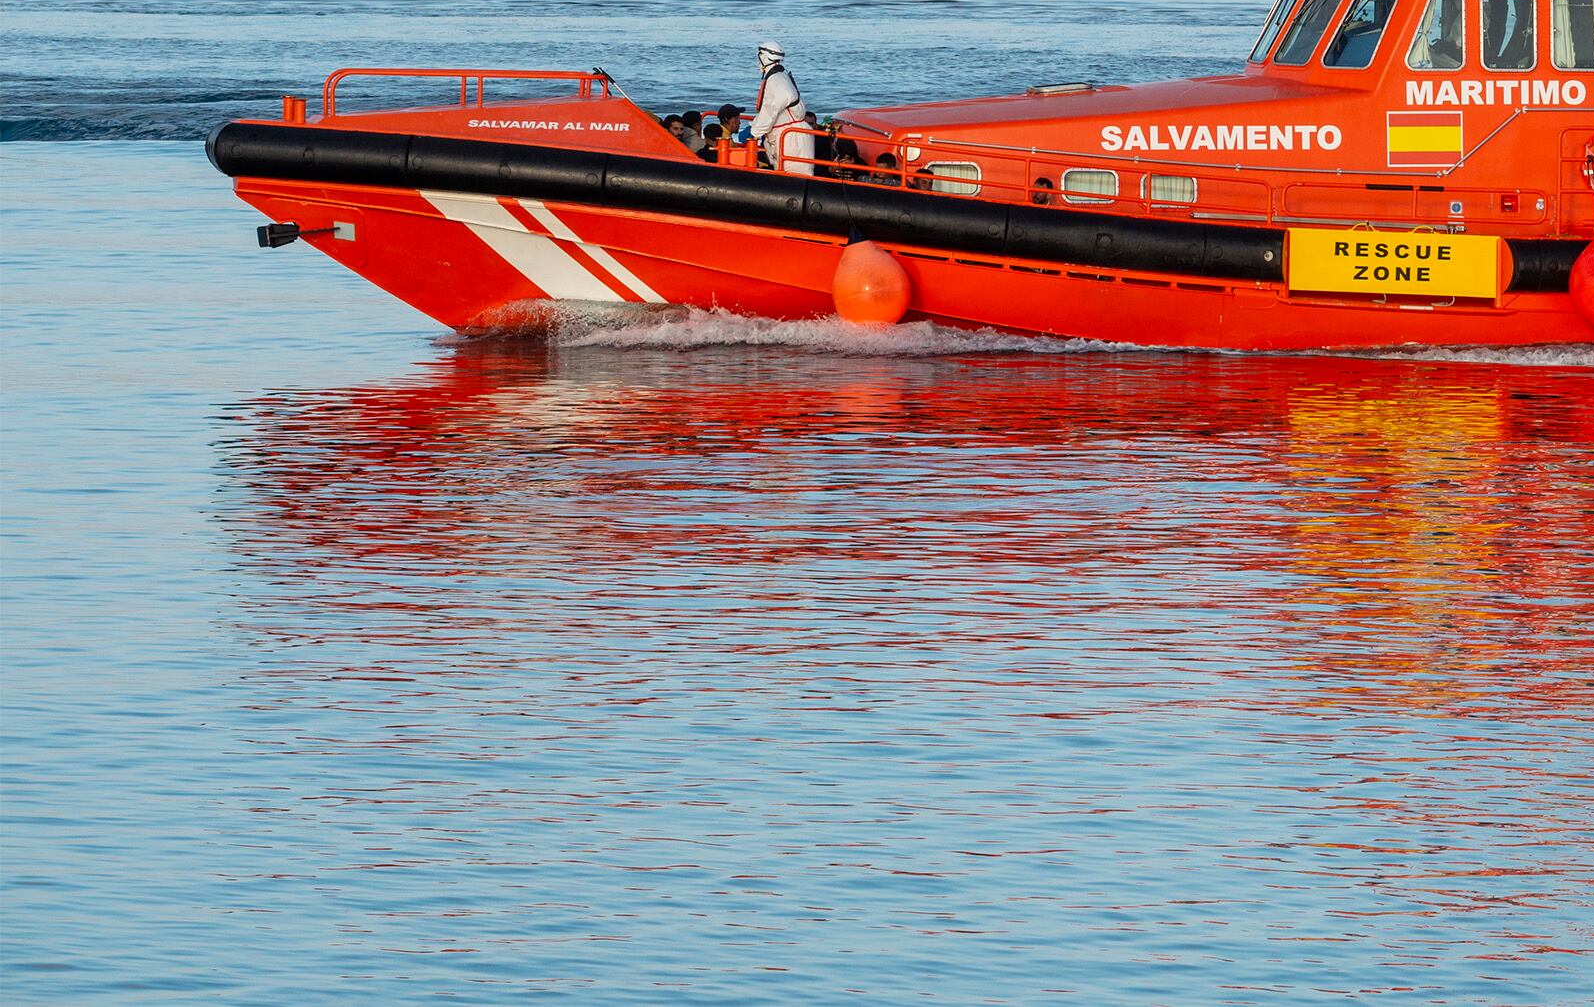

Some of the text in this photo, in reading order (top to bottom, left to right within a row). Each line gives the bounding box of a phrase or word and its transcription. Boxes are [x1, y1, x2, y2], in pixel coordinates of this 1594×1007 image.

[1406, 80, 1587, 106] MARITIMO
[468, 119, 630, 131] SALVAMAR AL NAIR
[1101, 125, 1342, 151] SALVAMENTO
[1334, 241, 1451, 260] RESCUE
[1353, 265, 1431, 282] ZONE
